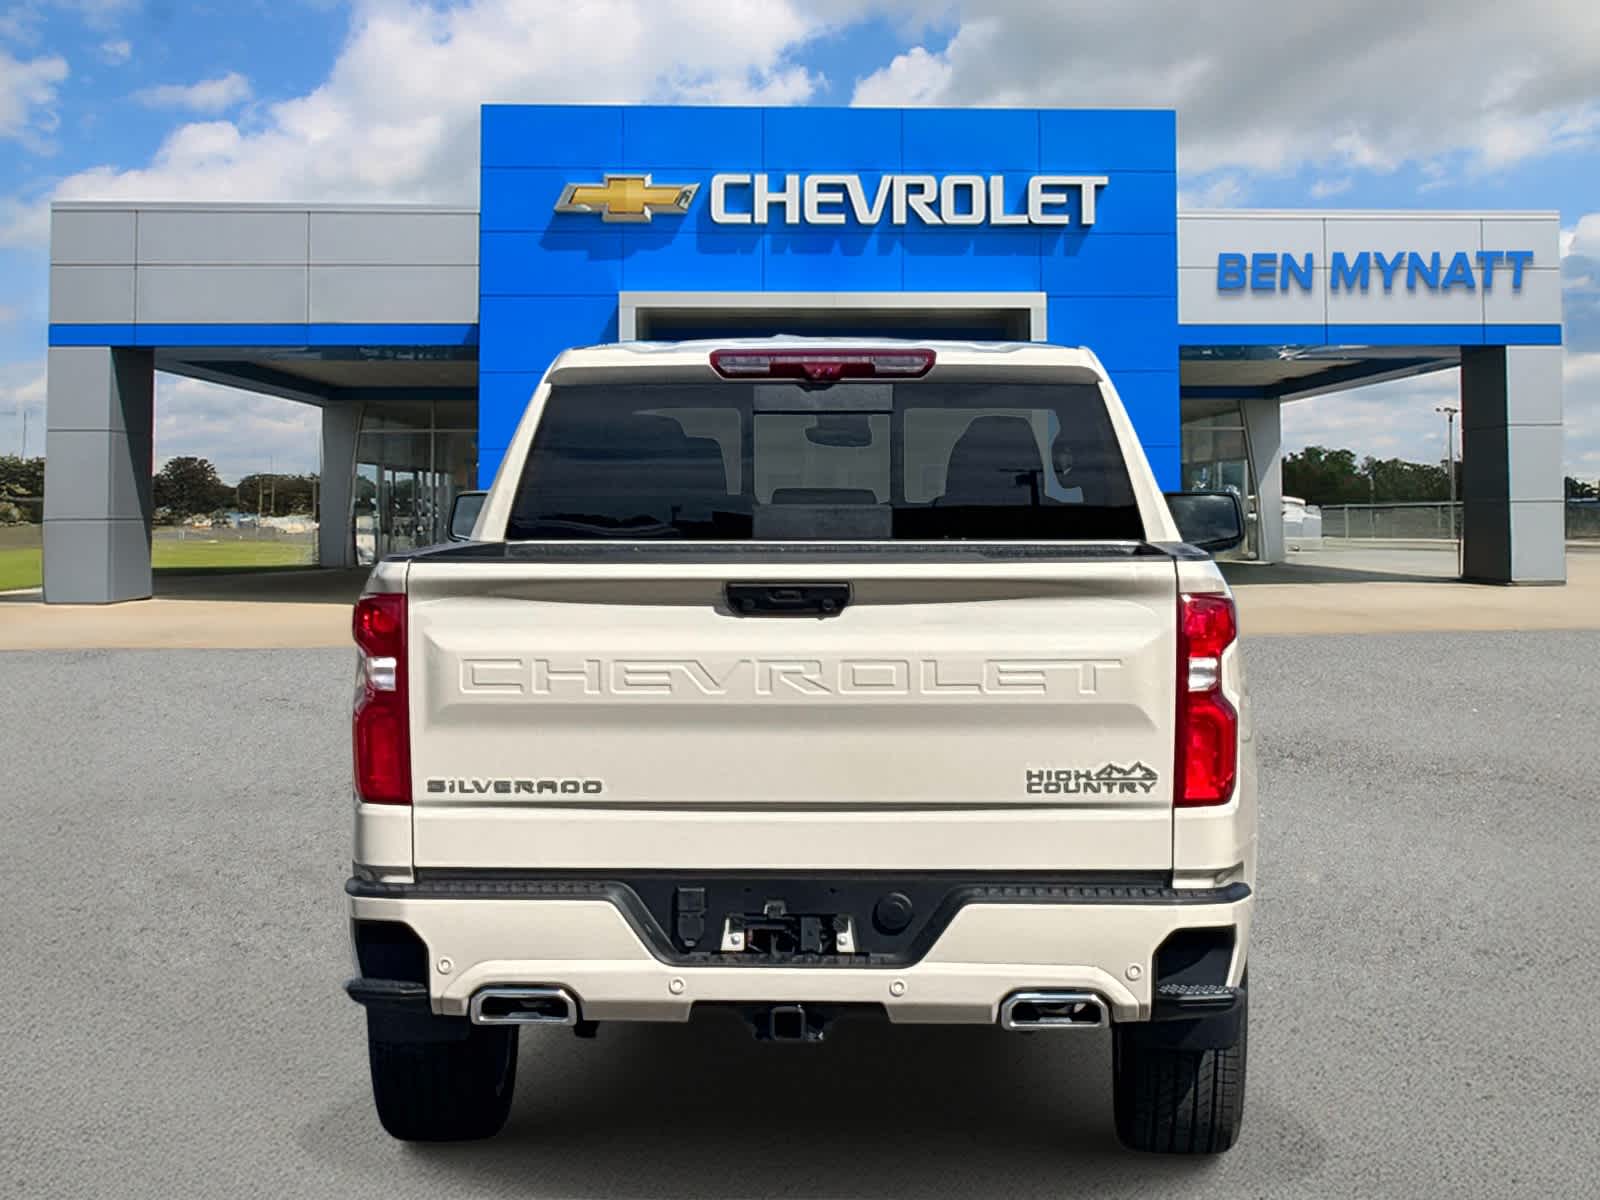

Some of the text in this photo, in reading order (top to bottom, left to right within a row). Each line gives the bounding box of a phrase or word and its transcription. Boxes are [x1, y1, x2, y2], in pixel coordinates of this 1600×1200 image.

[710, 173, 1109, 226] CHEVROLET
[1217, 250, 1534, 291] BEN MYNATT
[458, 658, 1122, 696] CHEVROLET
[427, 780, 602, 794] SILVERADO
[1026, 769, 1093, 781] HIGH
[1026, 781, 1156, 794] COUNTRY
